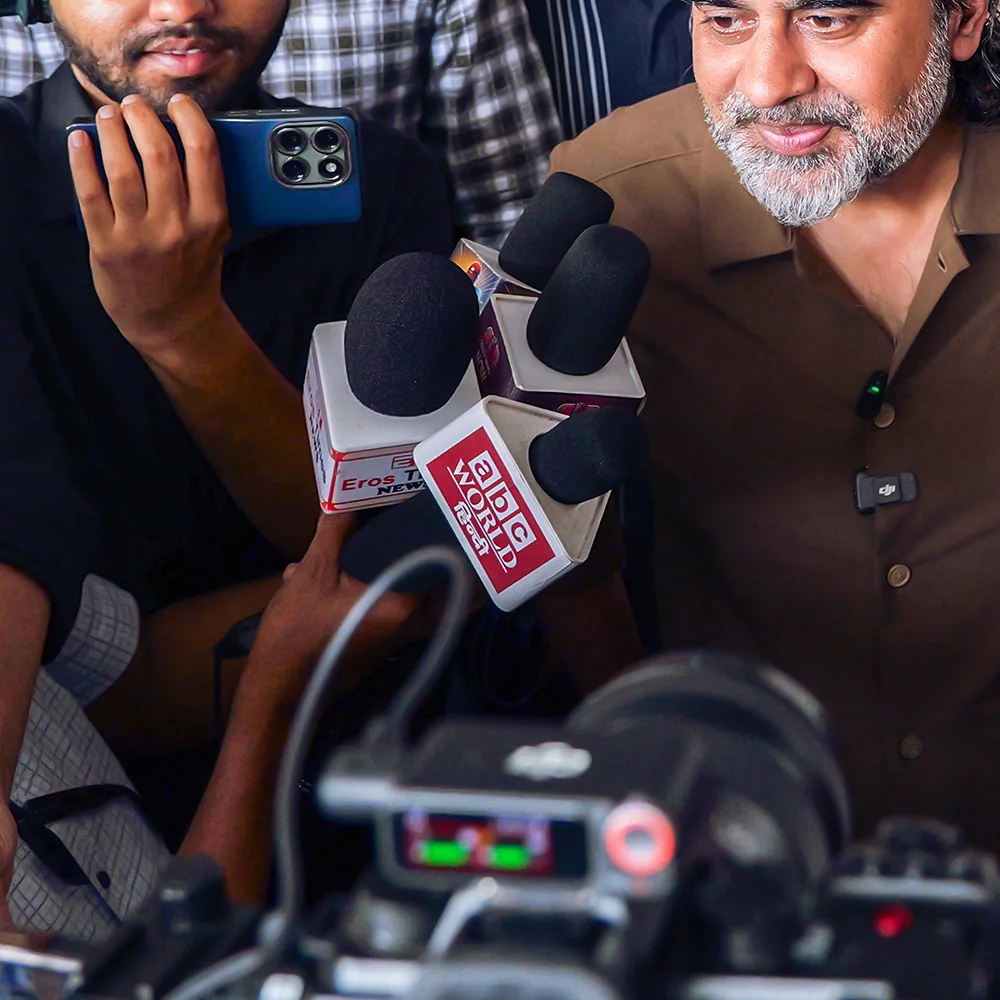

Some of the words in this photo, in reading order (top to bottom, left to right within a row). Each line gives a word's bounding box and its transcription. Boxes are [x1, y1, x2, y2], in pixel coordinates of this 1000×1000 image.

[341, 475, 395, 491] Eros
[377, 481, 427, 496] NEW
[471, 455, 532, 547] abc
[453, 457, 518, 570] WORLD
[453, 500, 490, 557] हिन्दी
